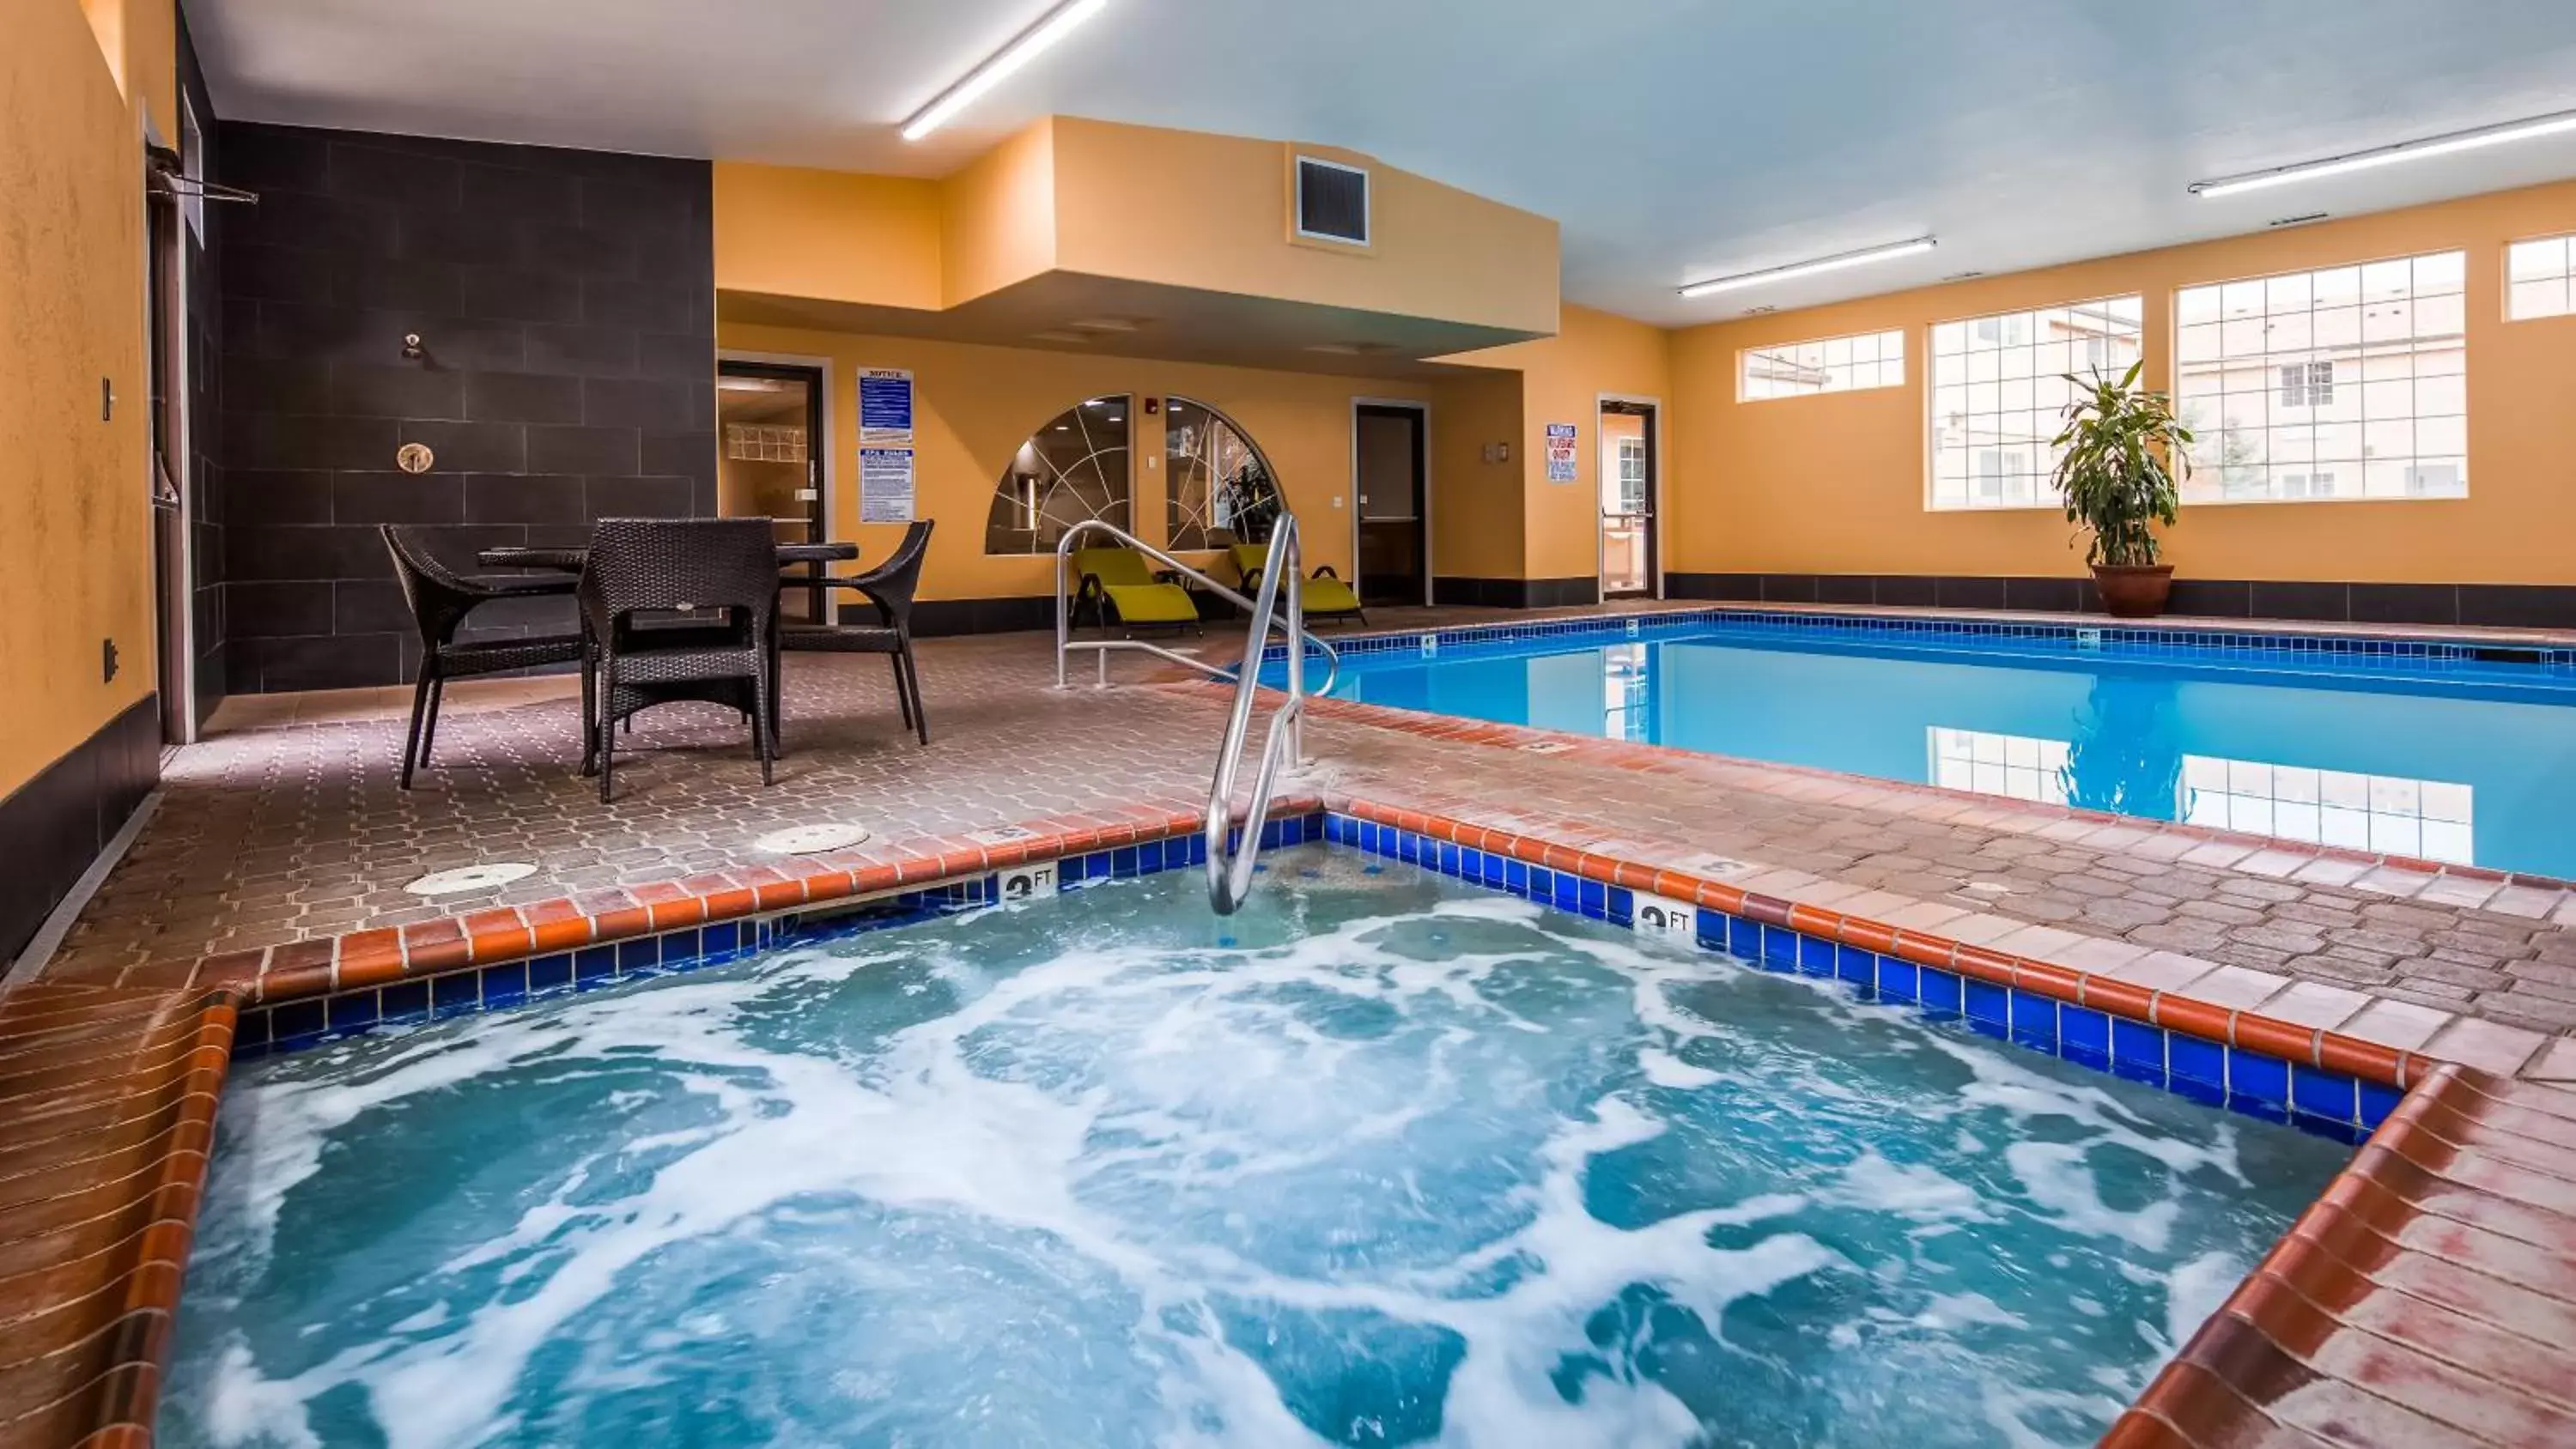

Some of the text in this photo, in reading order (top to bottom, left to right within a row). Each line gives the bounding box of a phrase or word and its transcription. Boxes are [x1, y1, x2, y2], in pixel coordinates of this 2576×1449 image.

[869, 370, 904, 379] NOTICE
[1035, 870, 1051, 887] FT
[1670, 911, 1689, 931] FT
